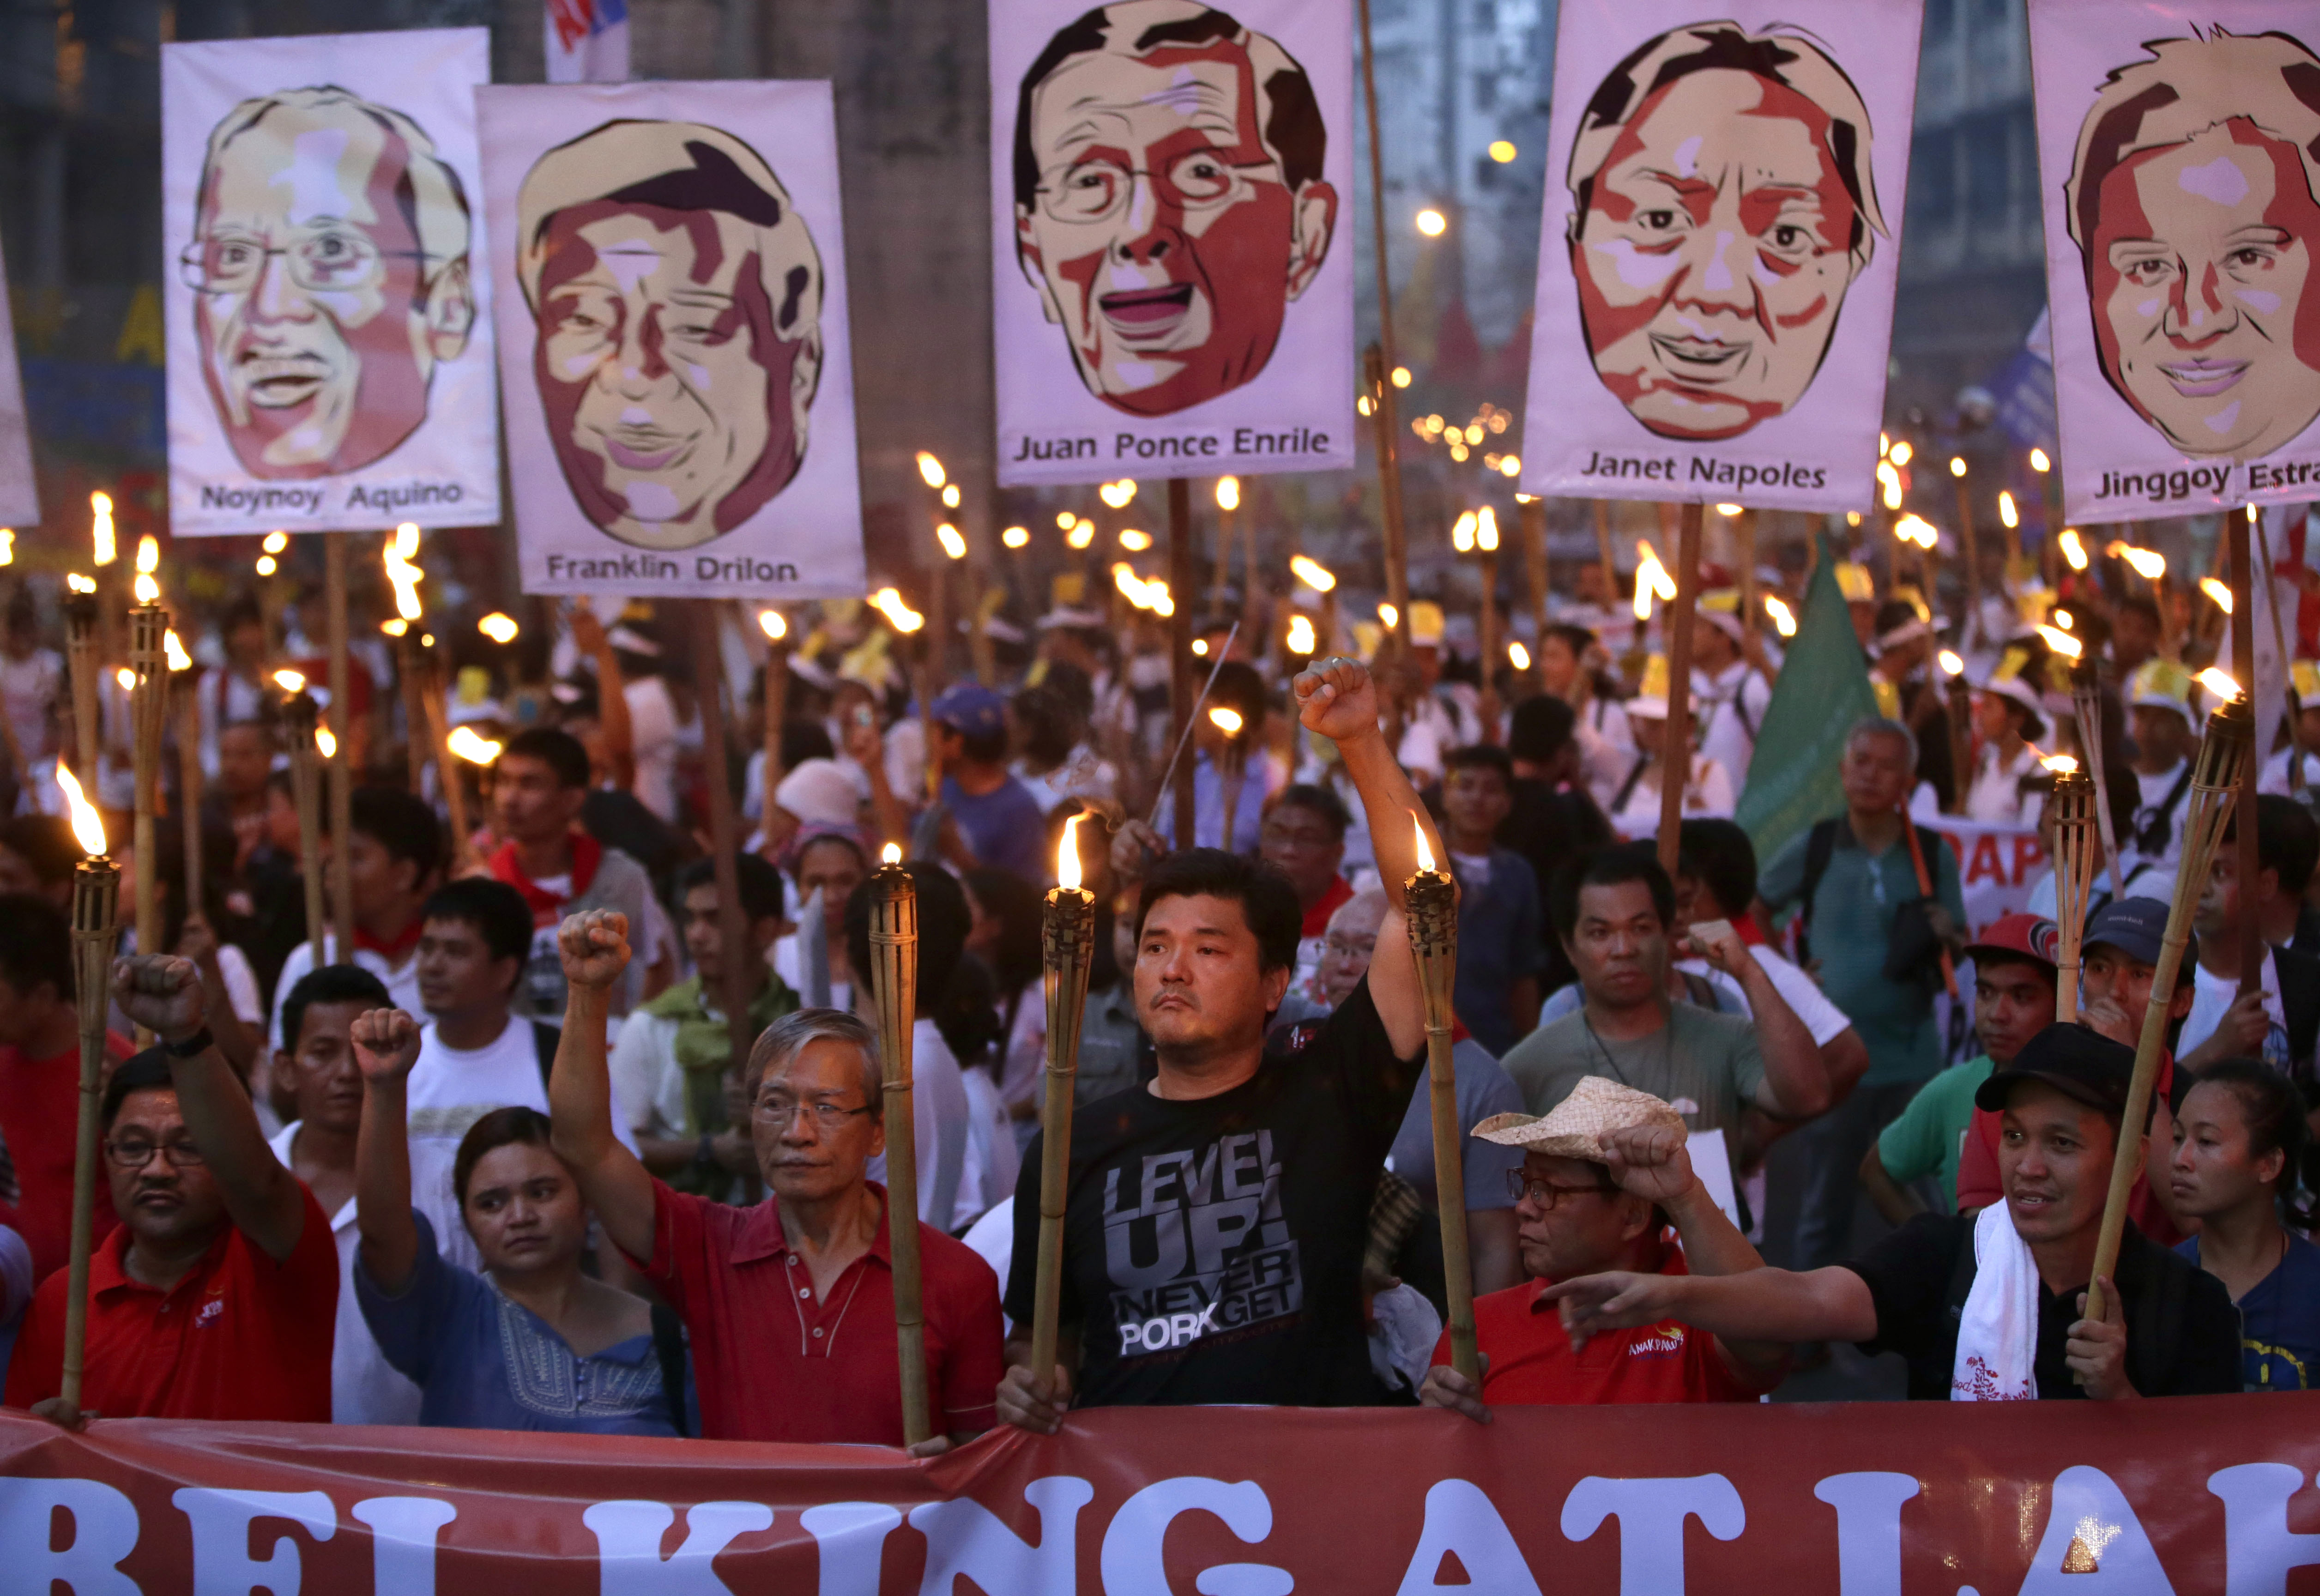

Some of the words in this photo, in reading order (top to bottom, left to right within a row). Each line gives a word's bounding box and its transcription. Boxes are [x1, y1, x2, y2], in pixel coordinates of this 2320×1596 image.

[1013, 435, 1098, 462] Juan
[1115, 432, 1219, 459] Ponce
[1233, 427, 1330, 454] Enrile
[1581, 451, 1677, 481] Janet
[1690, 457, 1826, 492] Napoles
[2095, 464, 2231, 502] Jinggoy
[201, 485, 322, 516] Noynoy
[346, 482, 462, 515] Aquino
[547, 554, 680, 580] Franklin
[696, 556, 798, 582] Drilon
[1114, 1247, 1293, 1322] NEVER
[1396, 1473, 1746, 1596] AT
